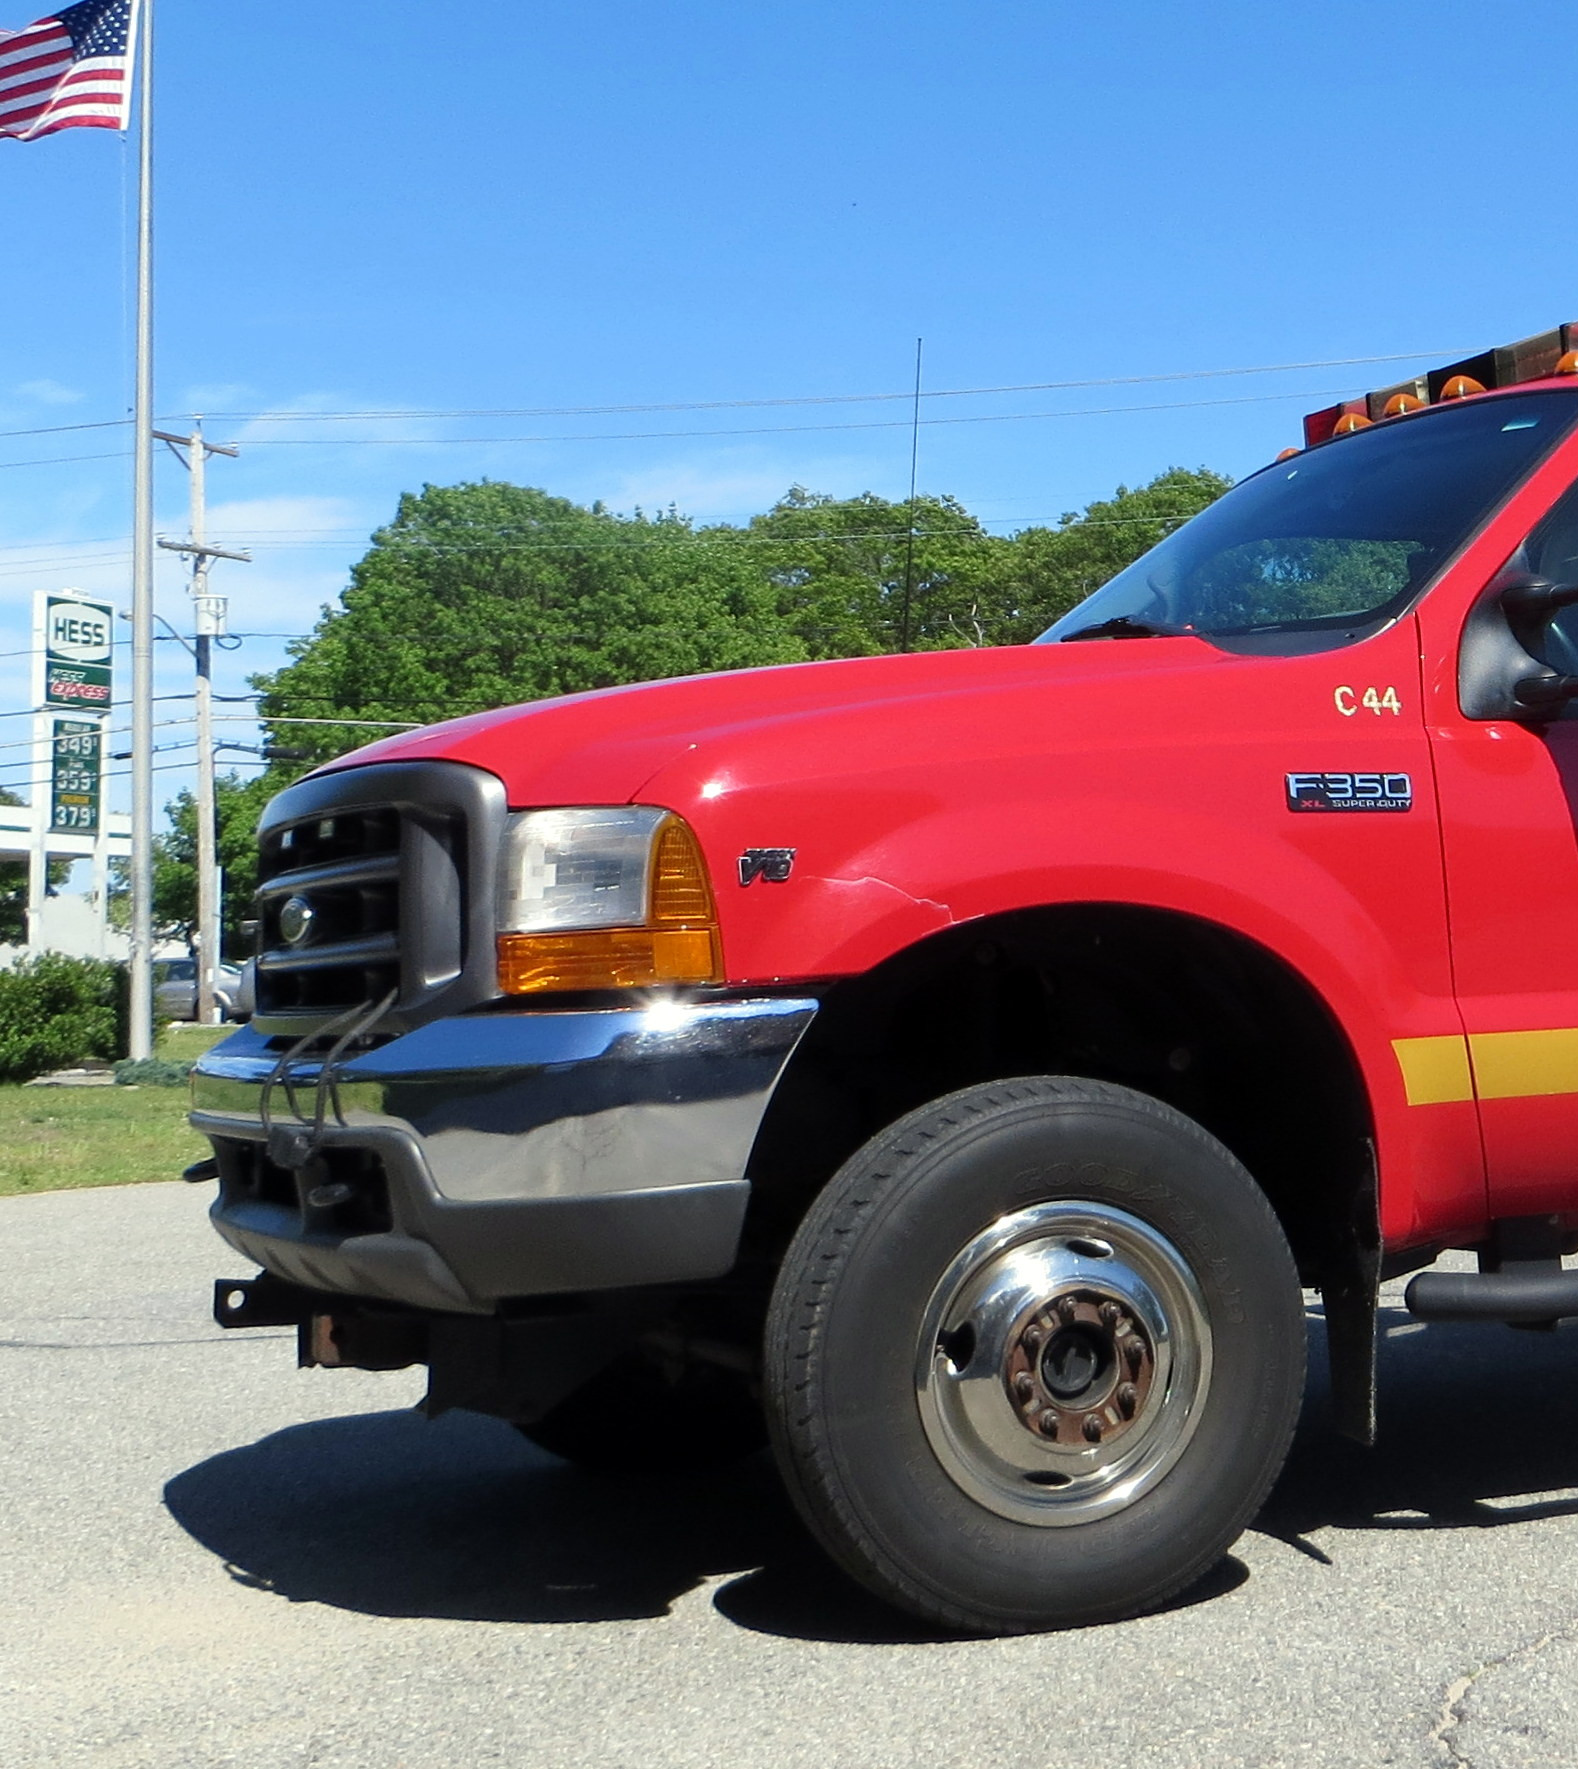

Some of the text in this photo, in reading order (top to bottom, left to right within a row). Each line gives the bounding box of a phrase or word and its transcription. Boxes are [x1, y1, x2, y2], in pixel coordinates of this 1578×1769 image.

[55, 617, 104, 647] HESS
[1333, 685, 1402, 717] C 44
[56, 805, 92, 828] 379
[1301, 799, 1412, 808] XL SUPER DUTY
